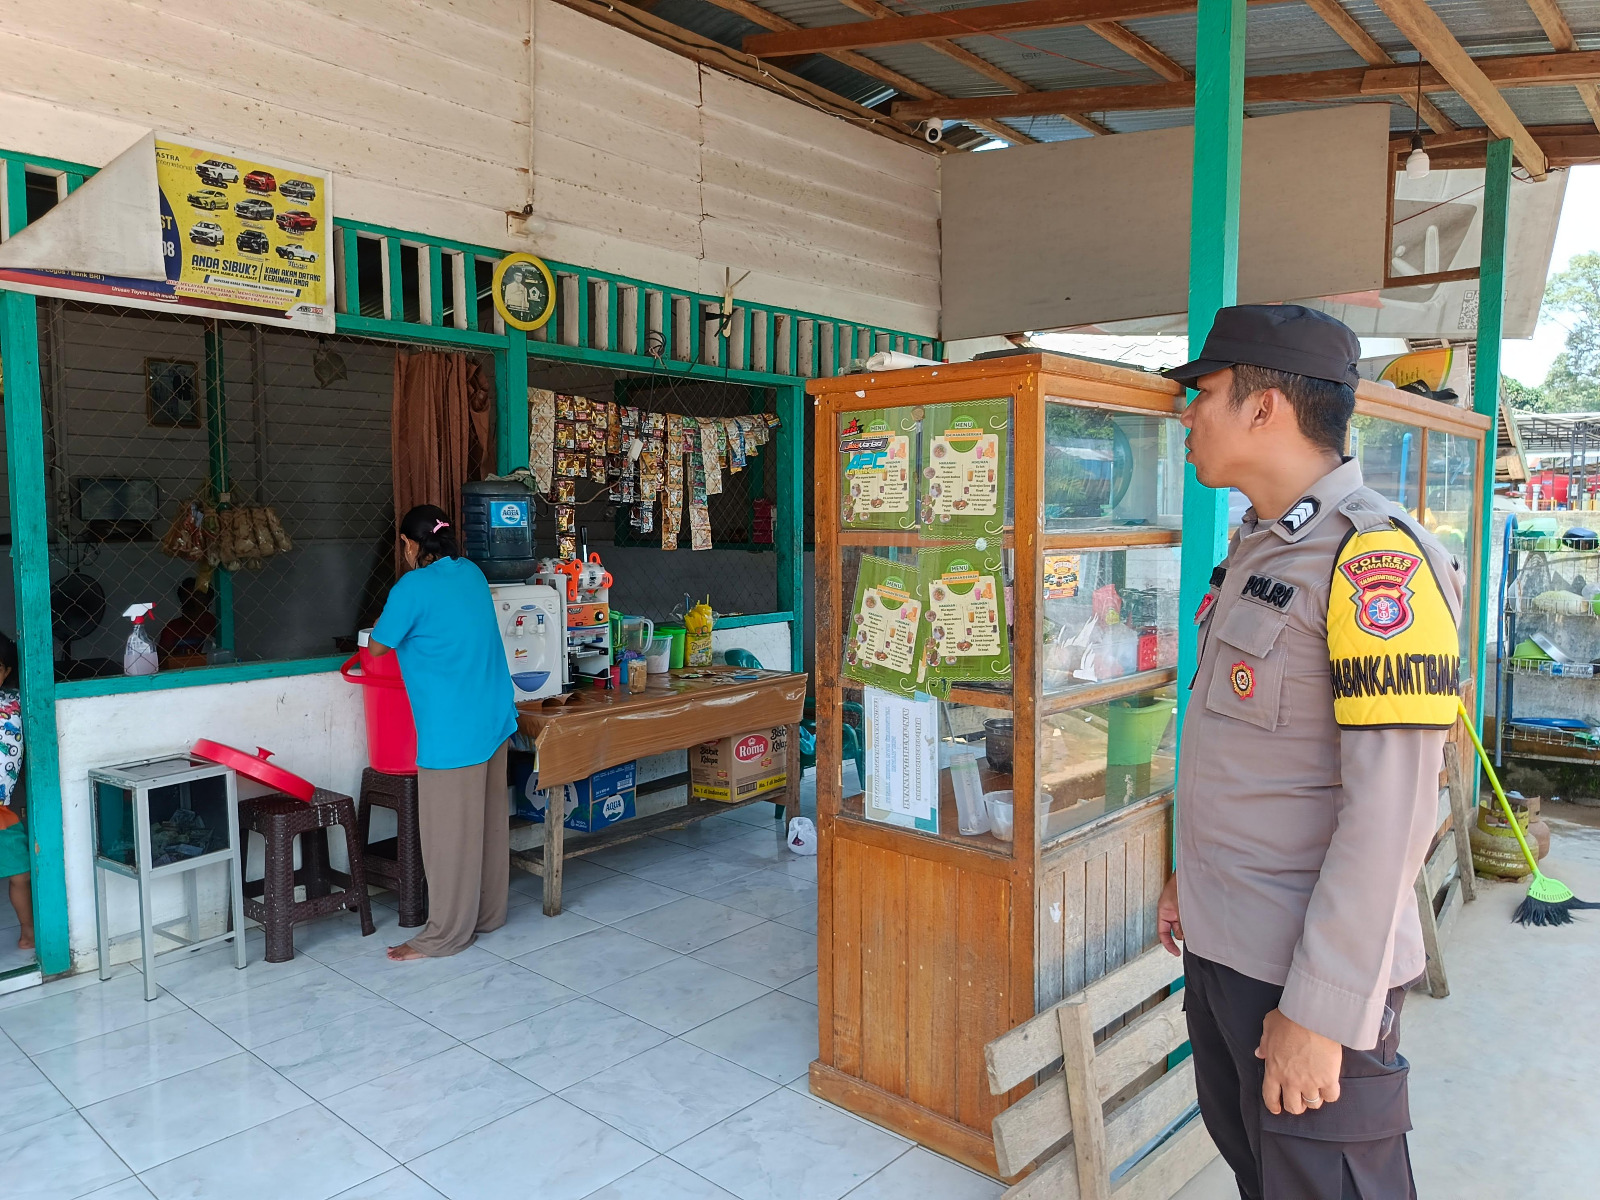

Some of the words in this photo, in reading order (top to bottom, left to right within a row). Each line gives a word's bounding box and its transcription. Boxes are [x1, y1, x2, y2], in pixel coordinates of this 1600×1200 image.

[156, 151, 180, 162] ASTRA
[192, 255, 219, 269] ANDA
[222, 260, 258, 275] SIBUK?
[264, 274, 292, 285] KERUMAH
[294, 279, 309, 287] ANDA
[265, 266, 280, 275] KAMI
[281, 269, 297, 277] AKAN
[298, 273, 320, 282] DATANG
[131, 288, 148, 296] Toyota
[845, 452, 887, 471] APC
[1350, 555, 1412, 573] POLRES
[1355, 562, 1406, 574] LAMANDAU
[1242, 575, 1294, 608] POLRI
[771, 726, 787, 740] Bisk
[739, 743, 764, 758] Roma
[700, 755, 718, 766] Kelapa
[605, 799, 622, 811] AQUA
